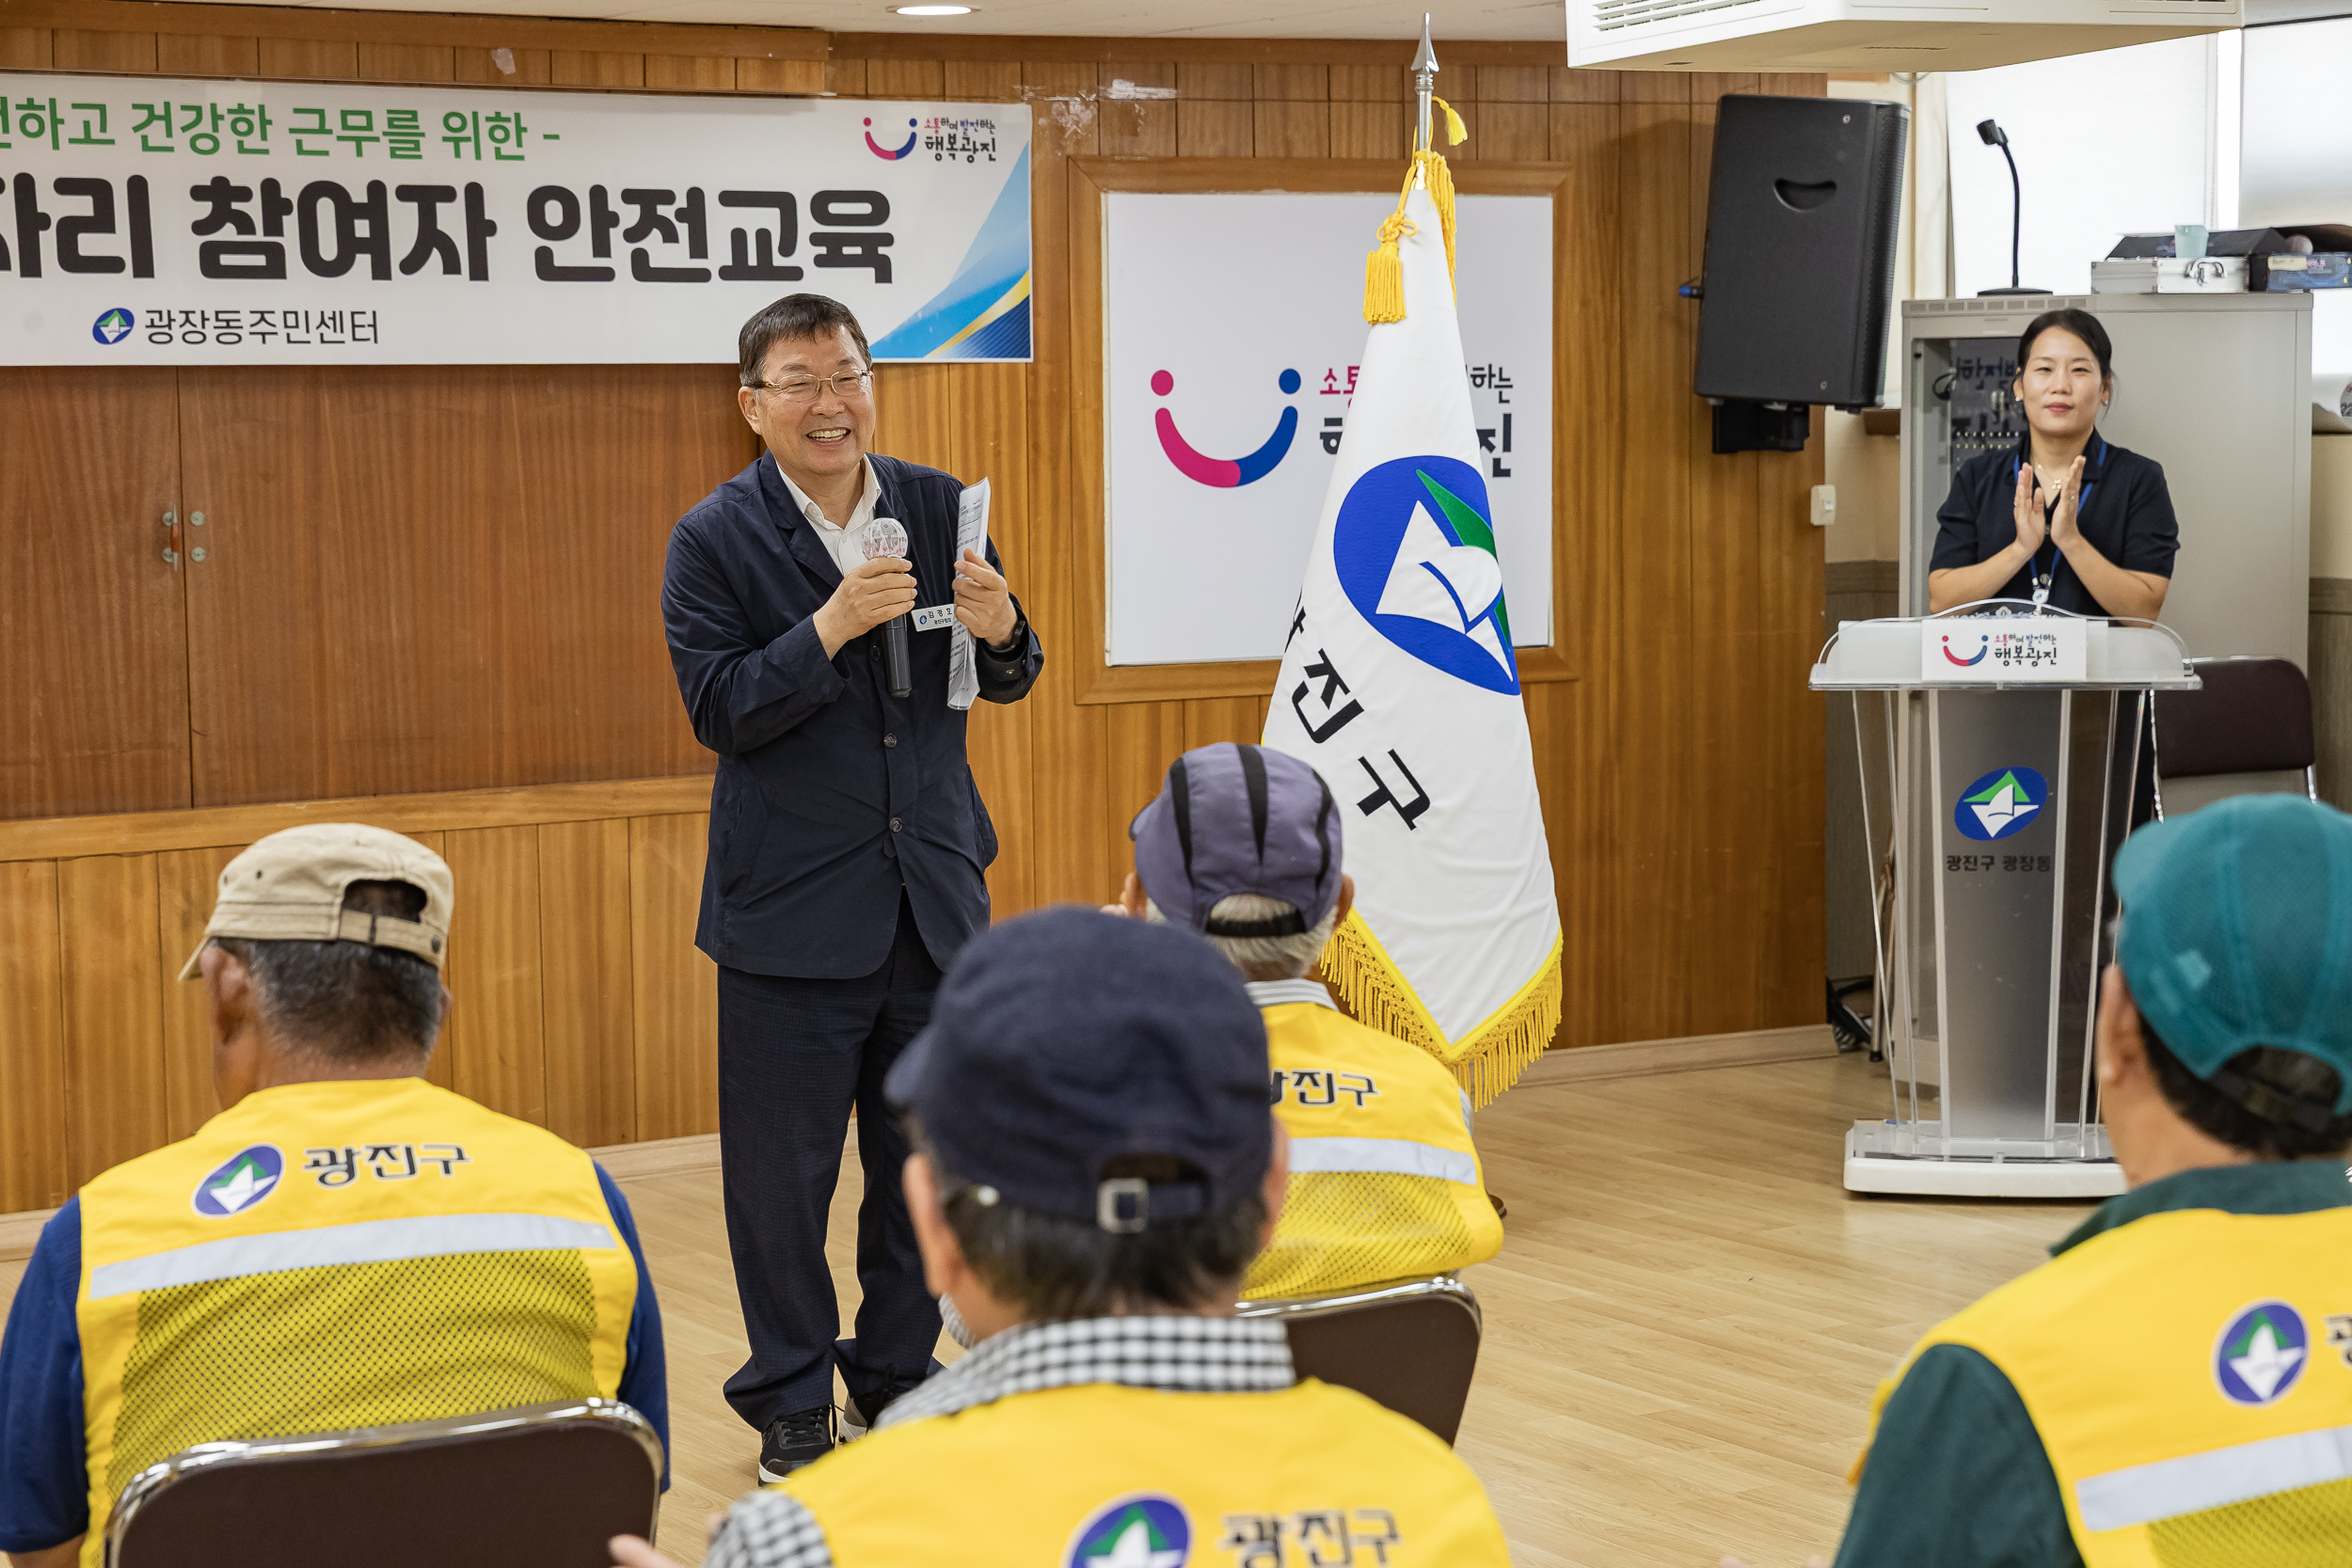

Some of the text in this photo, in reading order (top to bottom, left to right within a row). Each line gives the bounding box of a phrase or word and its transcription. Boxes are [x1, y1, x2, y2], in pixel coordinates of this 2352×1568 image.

[0, 96, 116, 150] 하고
[131, 101, 273, 155] 건강한
[288, 107, 425, 161] 근무를
[441, 110, 528, 162] 위한
[924, 134, 997, 164] 행복광진
[189, 175, 498, 281] 참여자
[527, 183, 895, 284] 안전교육
[144, 309, 379, 345] 광장동주민센터
[1994, 644, 2058, 668] 행복광진
[1284, 586, 1431, 832] 진구
[1946, 854, 2052, 873] 광진구 광장동
[303, 1142, 470, 1188] 광진구
[1218, 1508, 1402, 1568] 광진구
